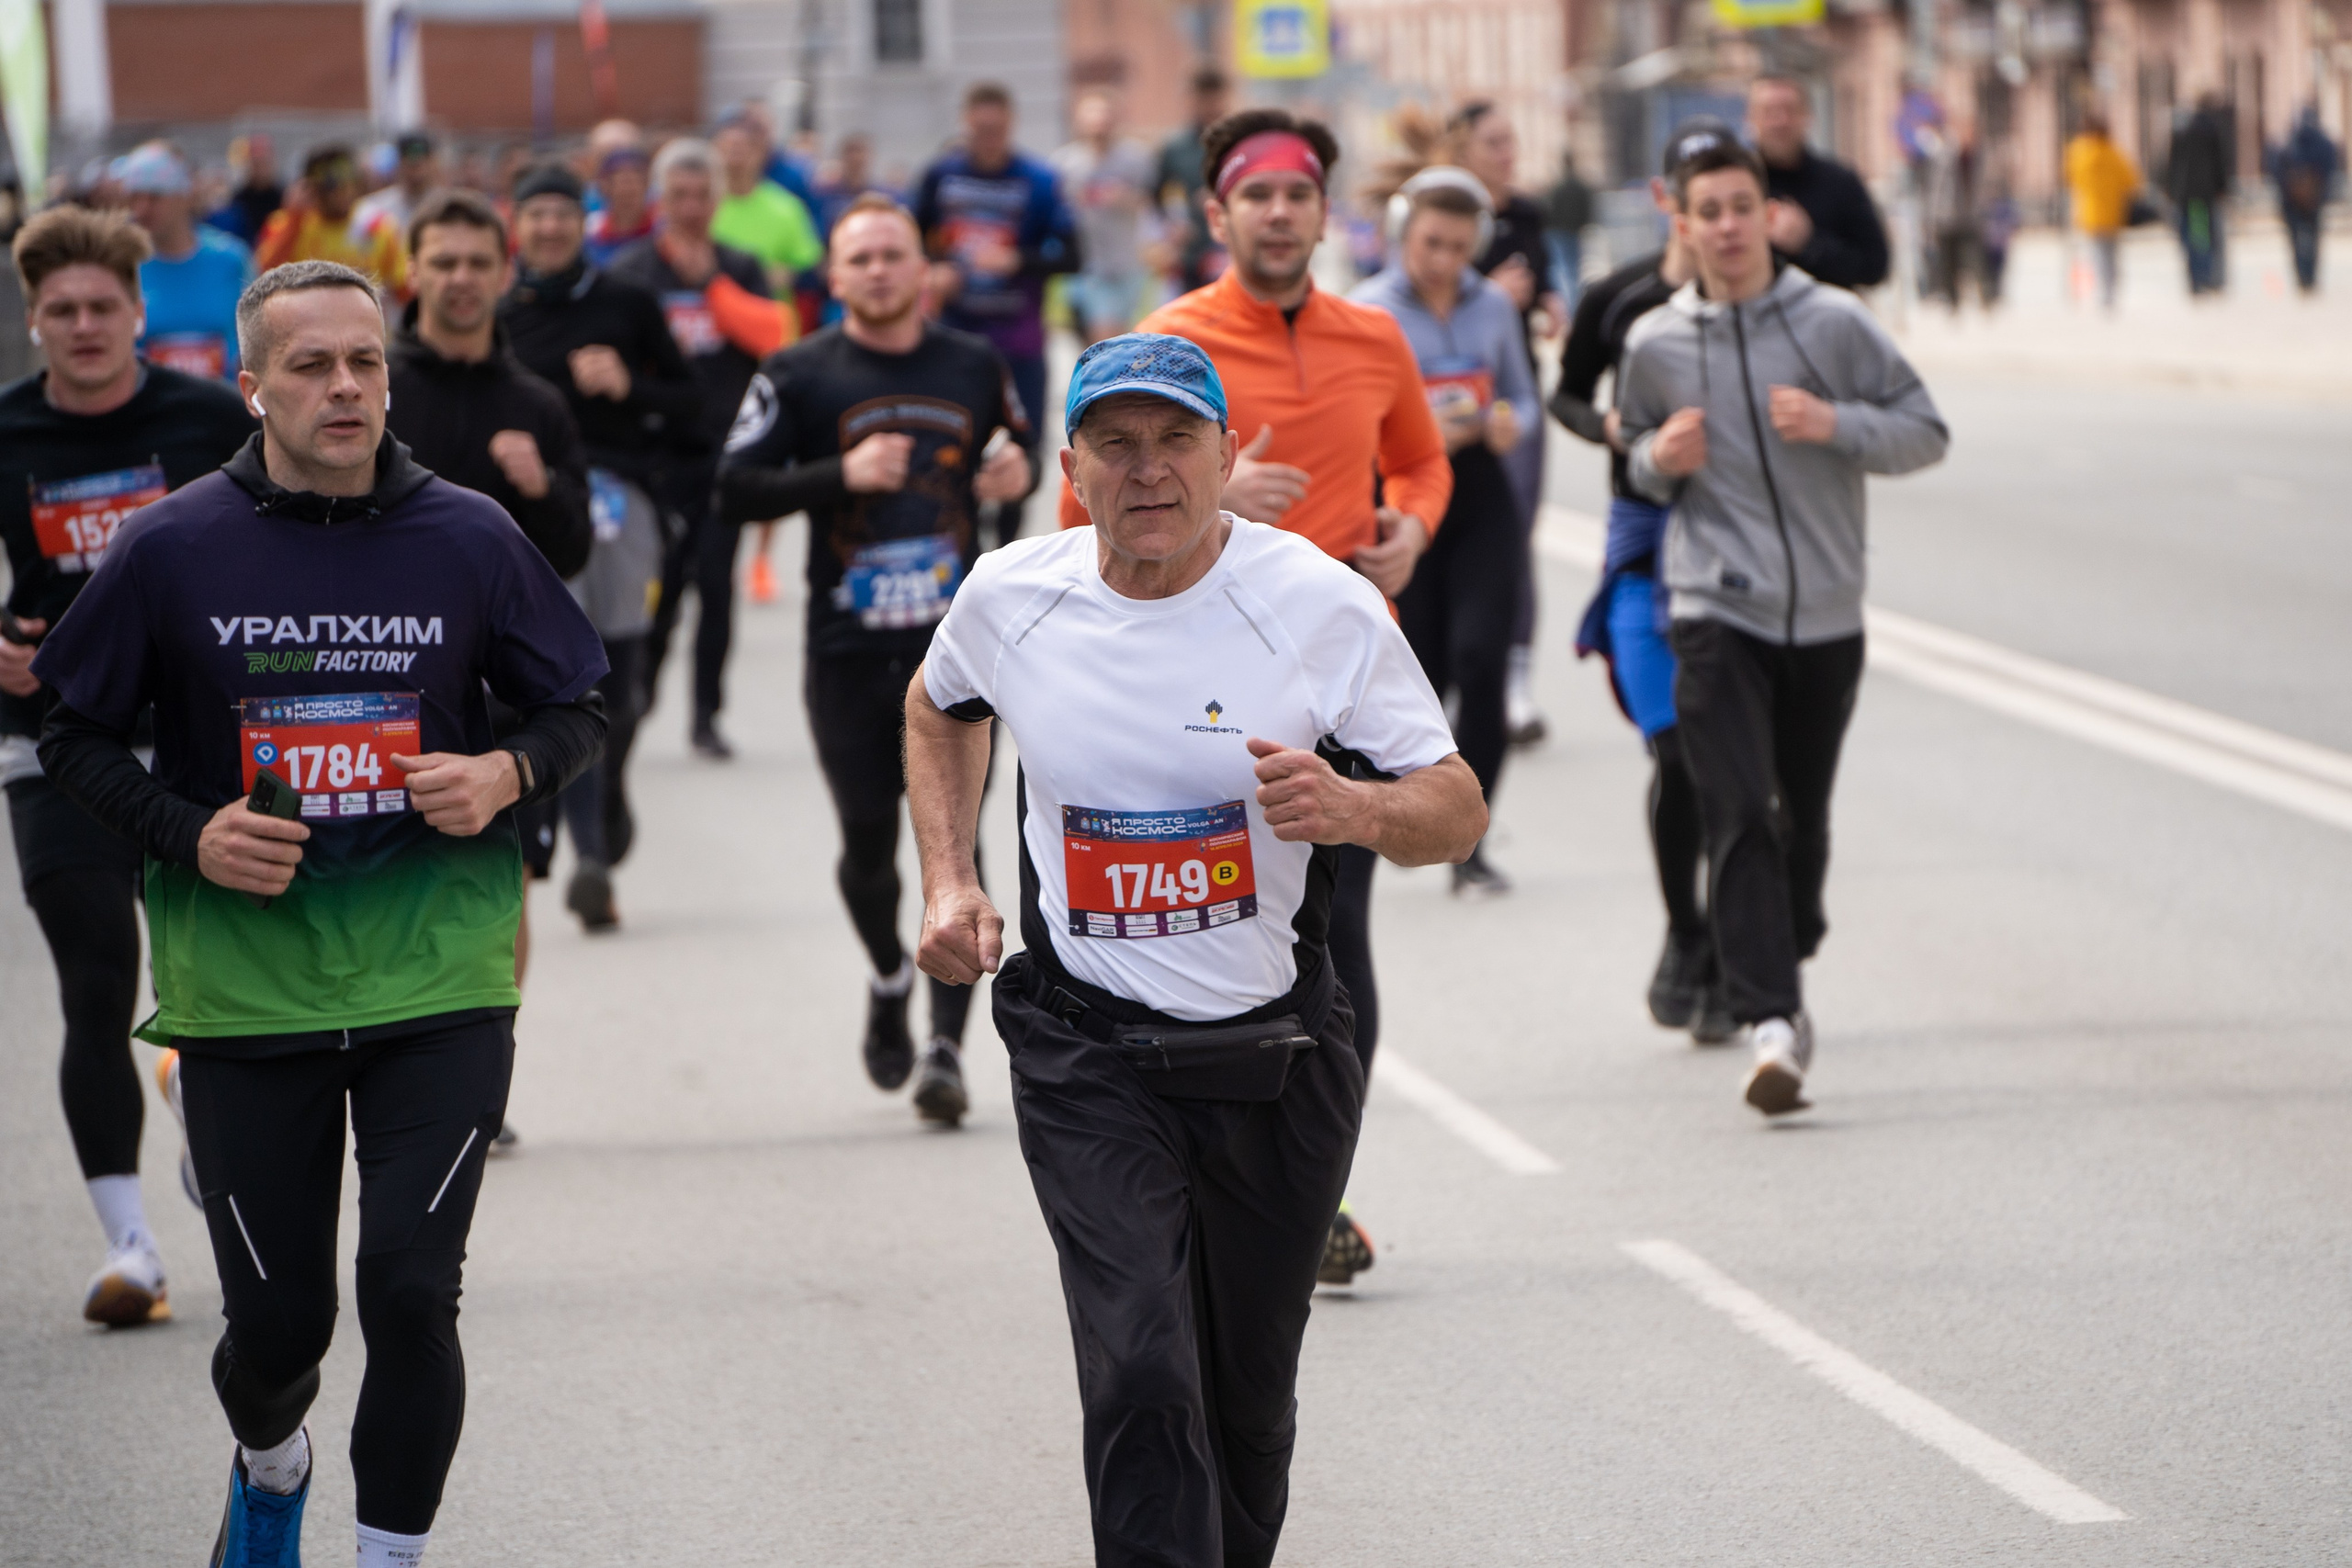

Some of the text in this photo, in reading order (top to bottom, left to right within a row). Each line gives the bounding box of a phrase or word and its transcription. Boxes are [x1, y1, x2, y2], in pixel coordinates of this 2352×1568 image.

[63, 507, 137, 552] 152
[209, 615, 443, 645] УРАЛХИМ
[306, 700, 364, 710] ПРОСТО
[294, 708, 364, 719] КОСМОС
[249, 731, 258, 739] 10
[1184, 725, 1243, 735] РОСНЕФТЬ
[283, 742, 382, 790] 1784
[1111, 817, 1186, 826] Я ПРОСТО
[1112, 824, 1187, 836] КОСМОС
[1219, 866, 1233, 879] B
[1105, 859, 1209, 908] 1749
